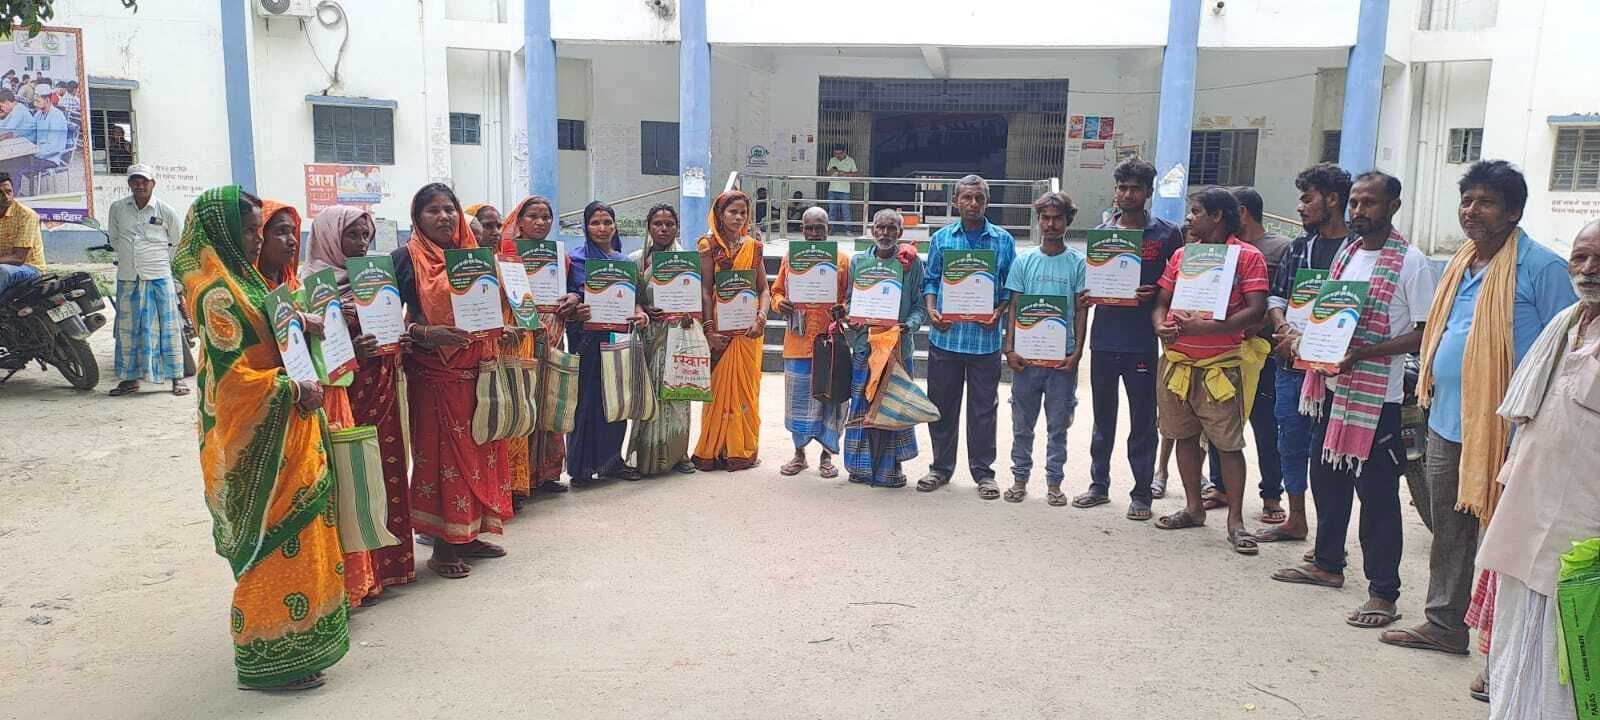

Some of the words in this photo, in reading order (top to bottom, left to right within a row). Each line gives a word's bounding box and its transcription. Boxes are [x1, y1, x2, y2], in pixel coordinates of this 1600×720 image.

[309, 174, 336, 188] आग
[53, 211, 82, 221] कटिहार
[1589, 693, 1600, 716] PARAS
